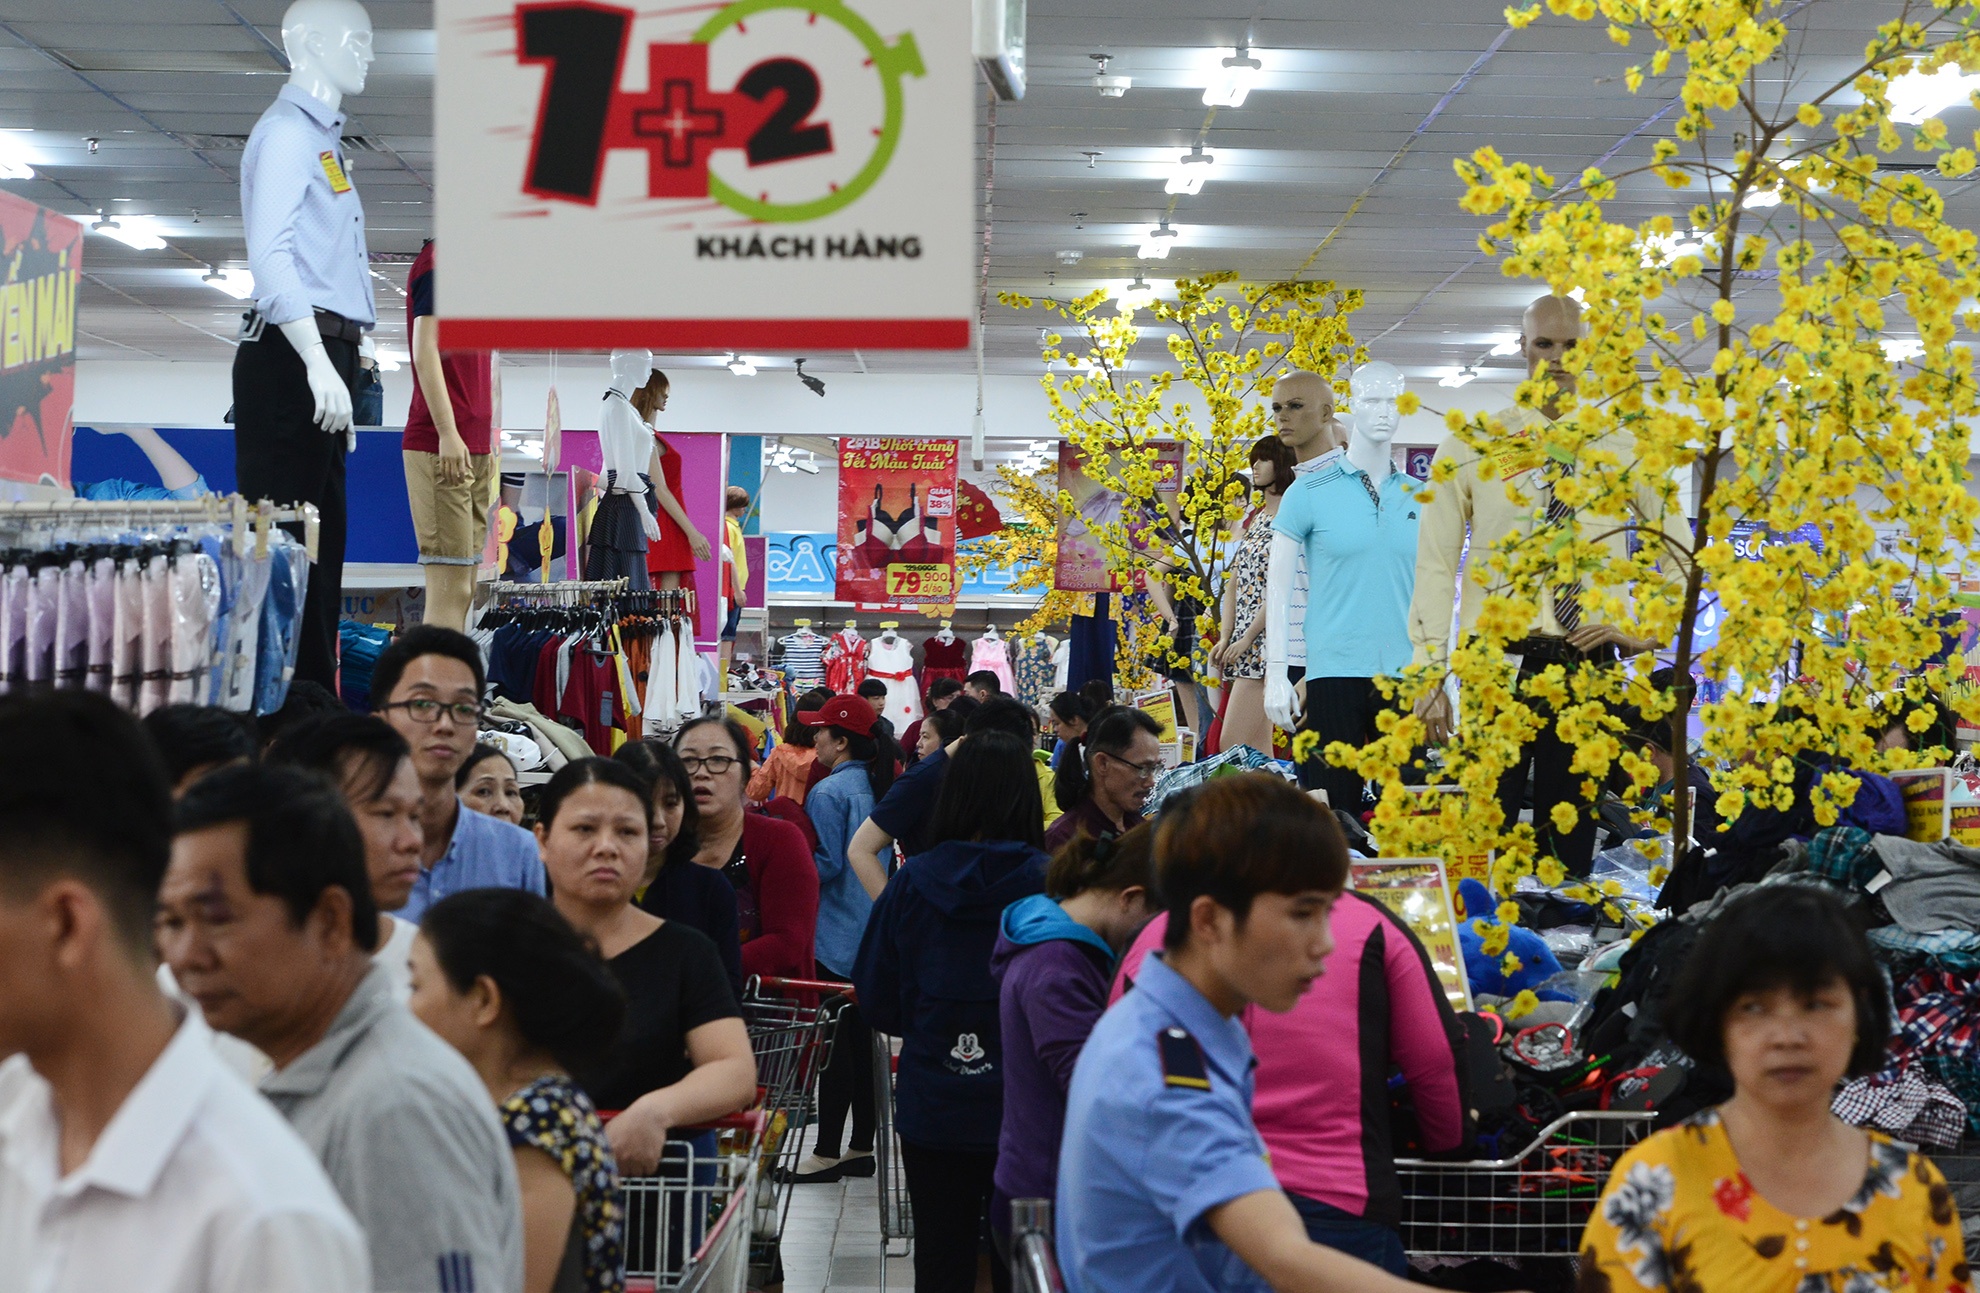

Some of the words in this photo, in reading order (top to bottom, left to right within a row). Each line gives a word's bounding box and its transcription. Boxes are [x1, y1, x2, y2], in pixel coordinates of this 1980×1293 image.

[696, 232, 815, 259] KHÁCH
[825, 230, 923, 259] HÀNG
[916, 441, 956, 458] trang
[842, 451, 867, 468] Tết
[869, 452, 909, 473] Mậu
[929, 500, 951, 509] 38%
[340, 595, 375, 619] ỤC
